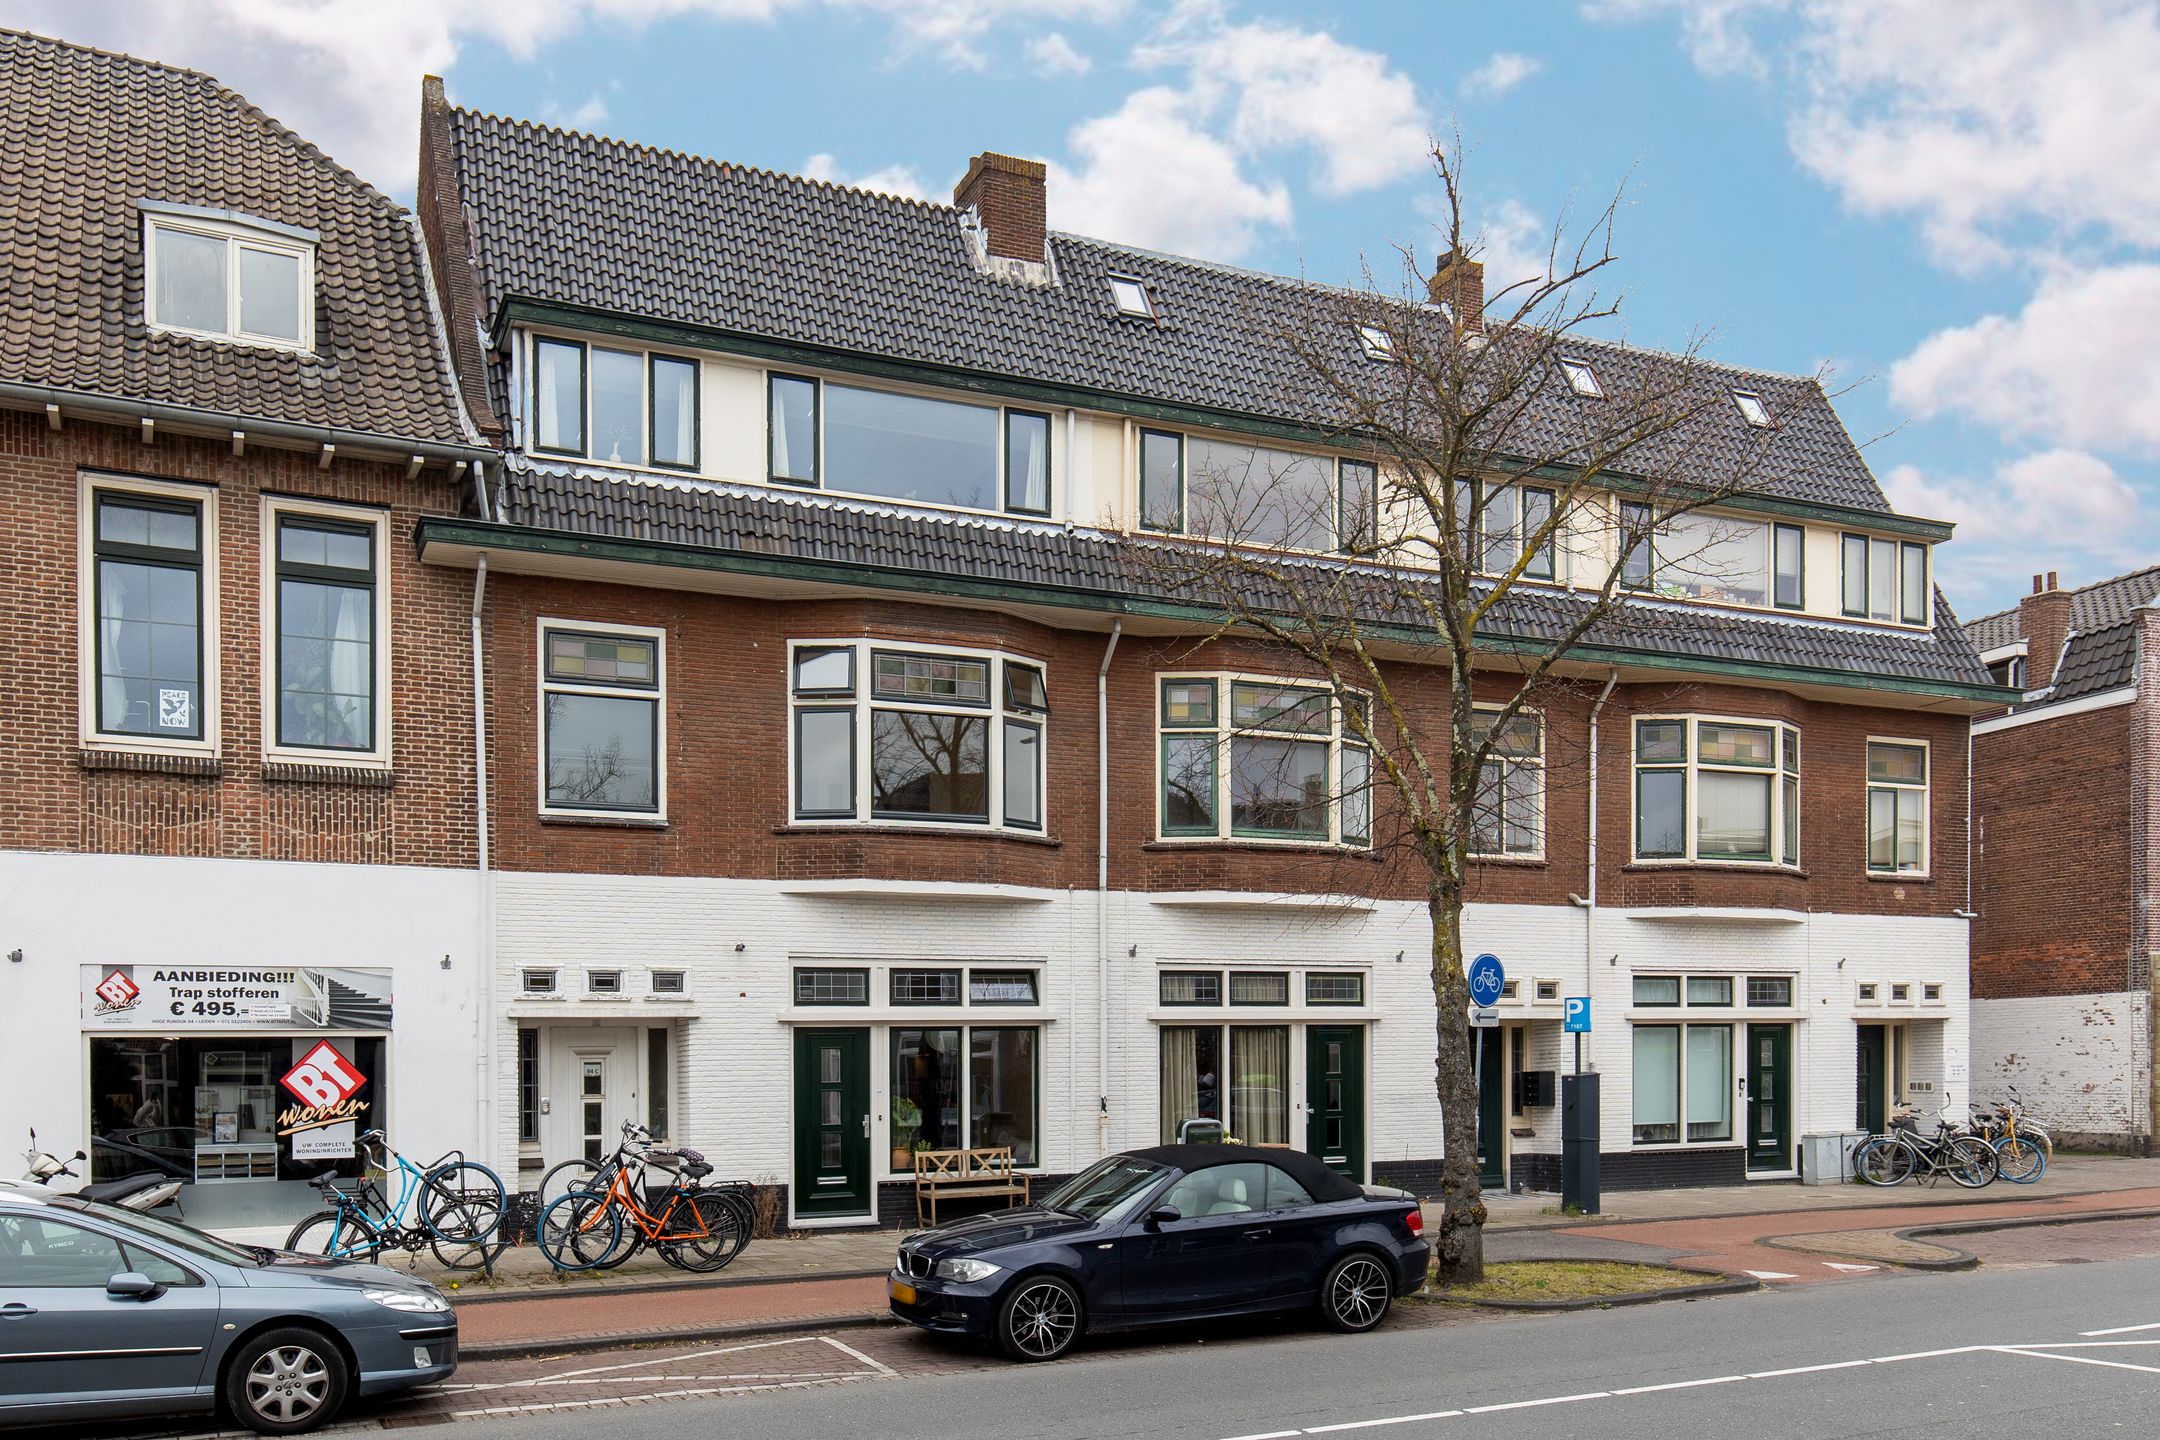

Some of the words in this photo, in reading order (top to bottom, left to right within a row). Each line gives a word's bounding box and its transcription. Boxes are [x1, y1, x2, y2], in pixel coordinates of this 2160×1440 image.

[162, 691, 186, 699] PEACE
[162, 717, 186, 726] NOW
[153, 970, 295, 983] AANBIEDING!!!
[99, 972, 134, 1002] BT
[169, 987, 203, 1000] Trap
[207, 987, 280, 999] stofferen
[170, 1001, 185, 1016] €
[1566, 999, 1584, 1023] P
[286, 1045, 356, 1110] BT
[277, 1099, 370, 1126] wonen
[48, 1240, 74, 1249] KYMCO
